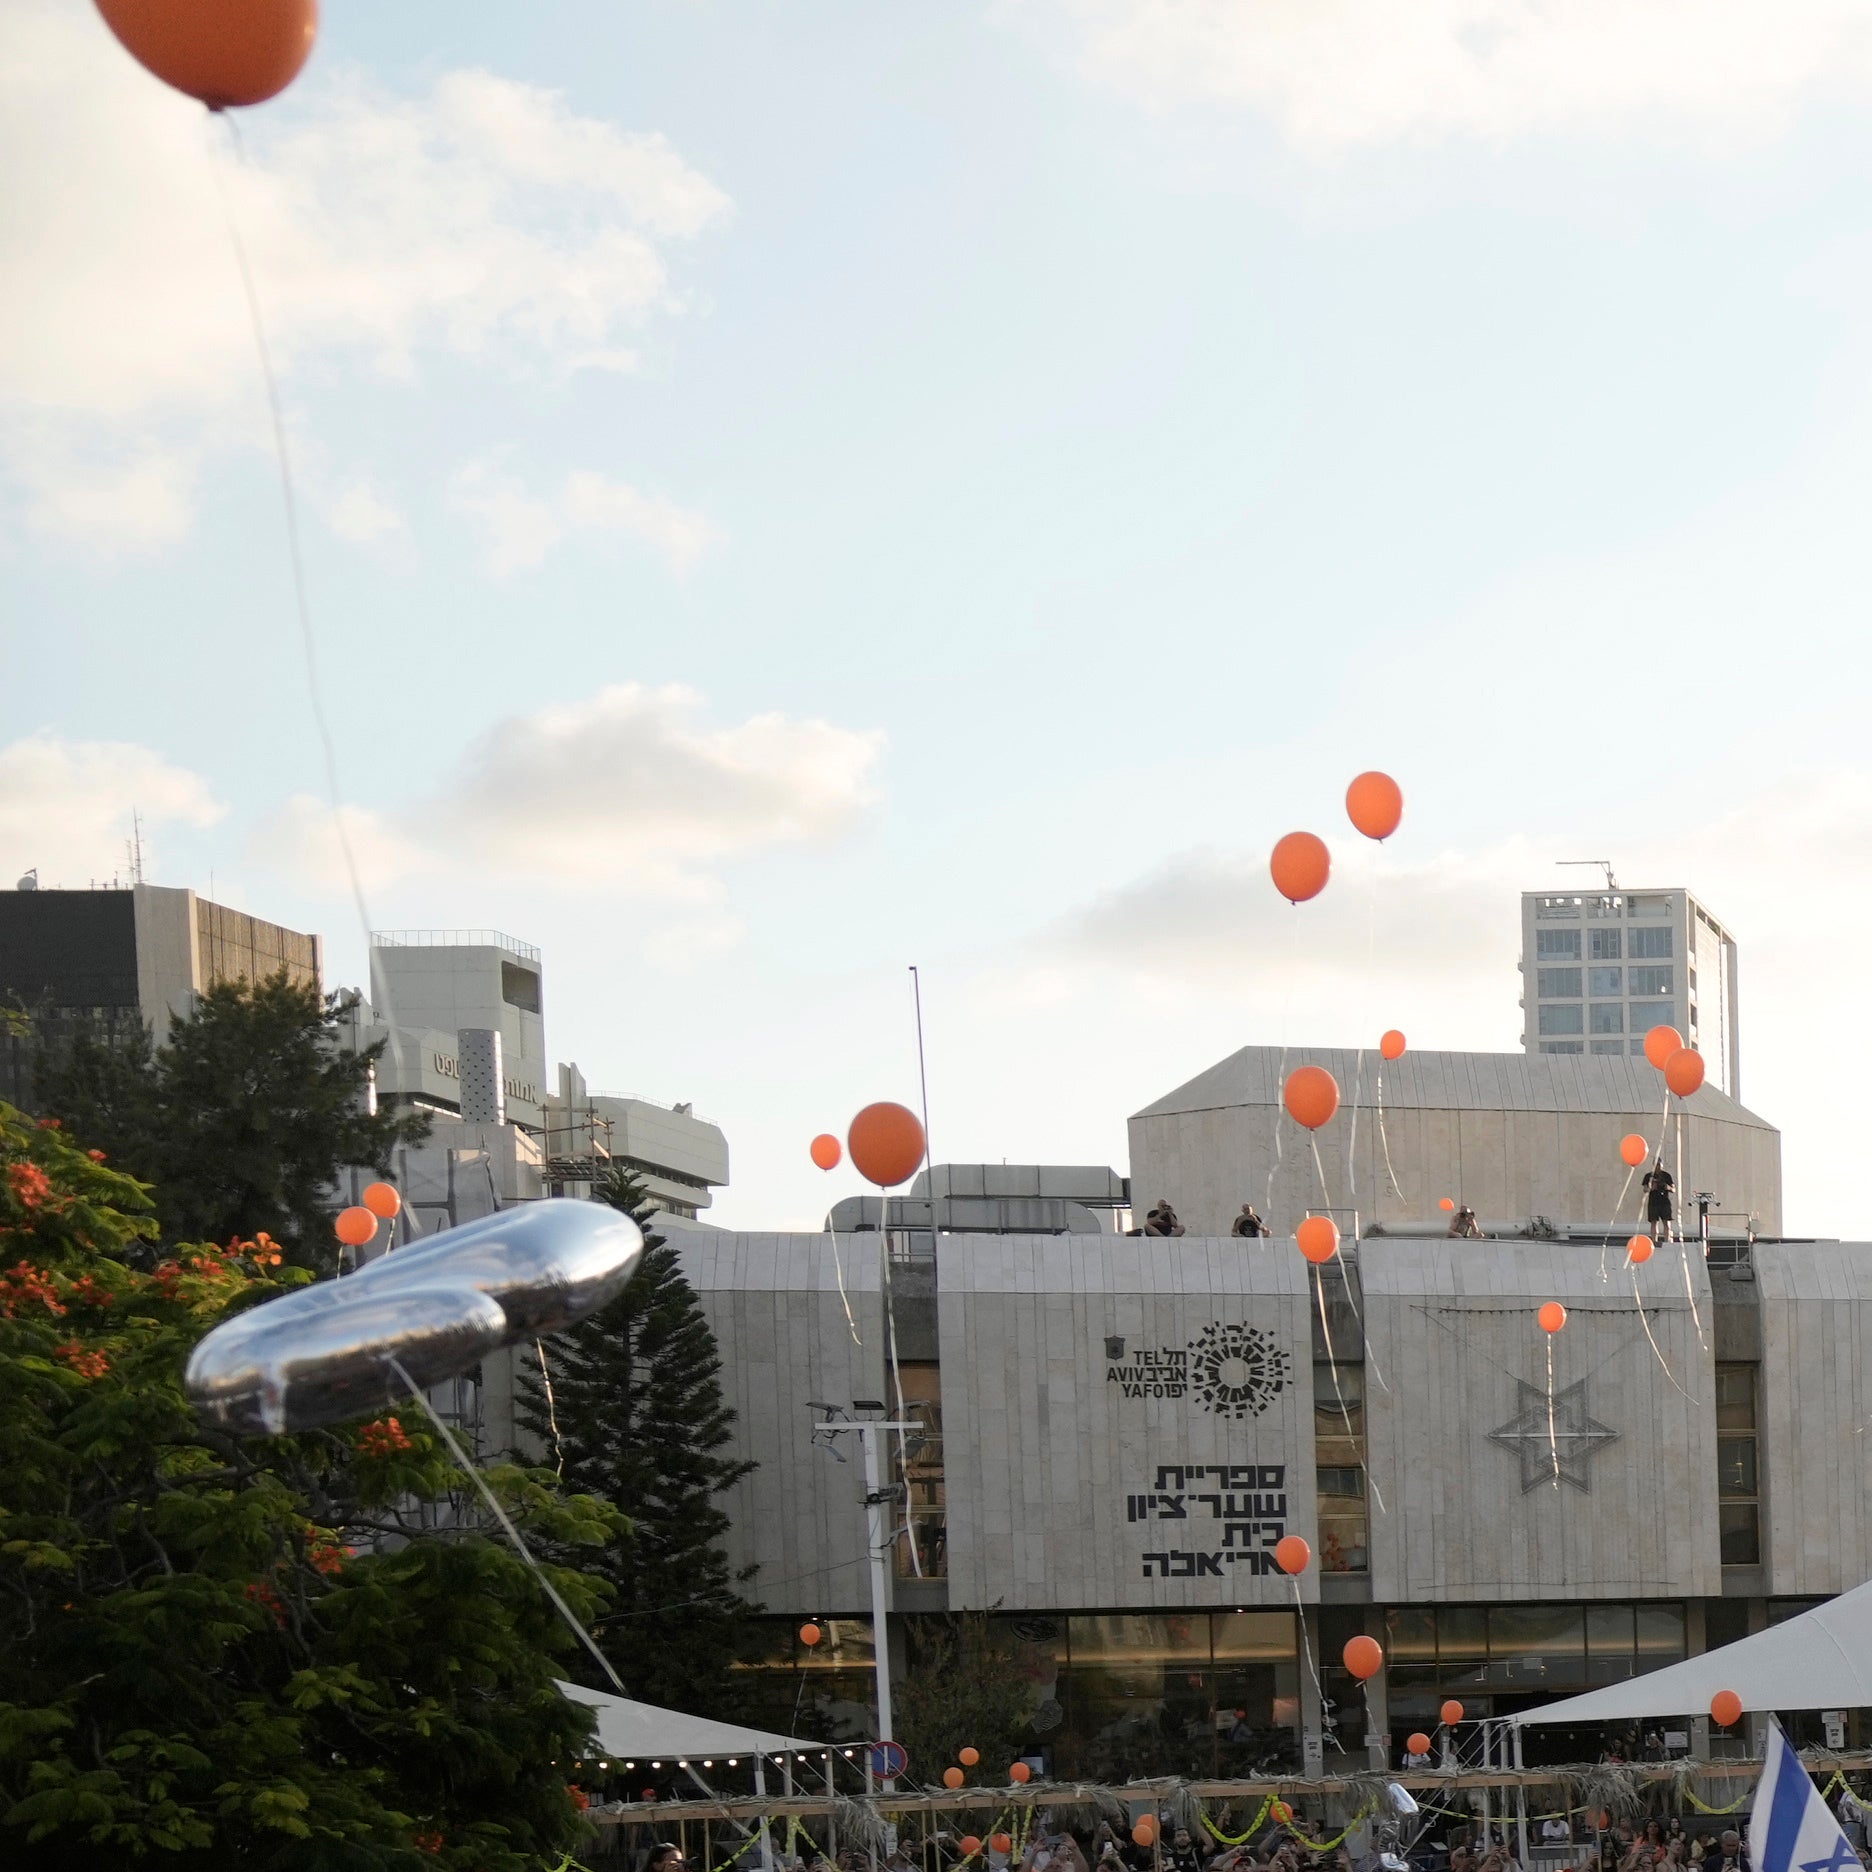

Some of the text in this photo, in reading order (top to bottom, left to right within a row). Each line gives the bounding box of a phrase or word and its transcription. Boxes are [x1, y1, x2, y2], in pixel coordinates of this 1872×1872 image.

[1133, 1351, 1161, 1366] TEL
[1162, 1347, 1187, 1366] תל
[1107, 1367, 1143, 1382] AVIV
[1144, 1367, 1187, 1382] אביב
[1122, 1384, 1163, 1399] YAFO
[1163, 1384, 1187, 1399] יפו
[1154, 1466, 1285, 1490] ספריית
[1221, 1523, 1284, 1547] בית
[1142, 1550, 1288, 1577] אריאלה
